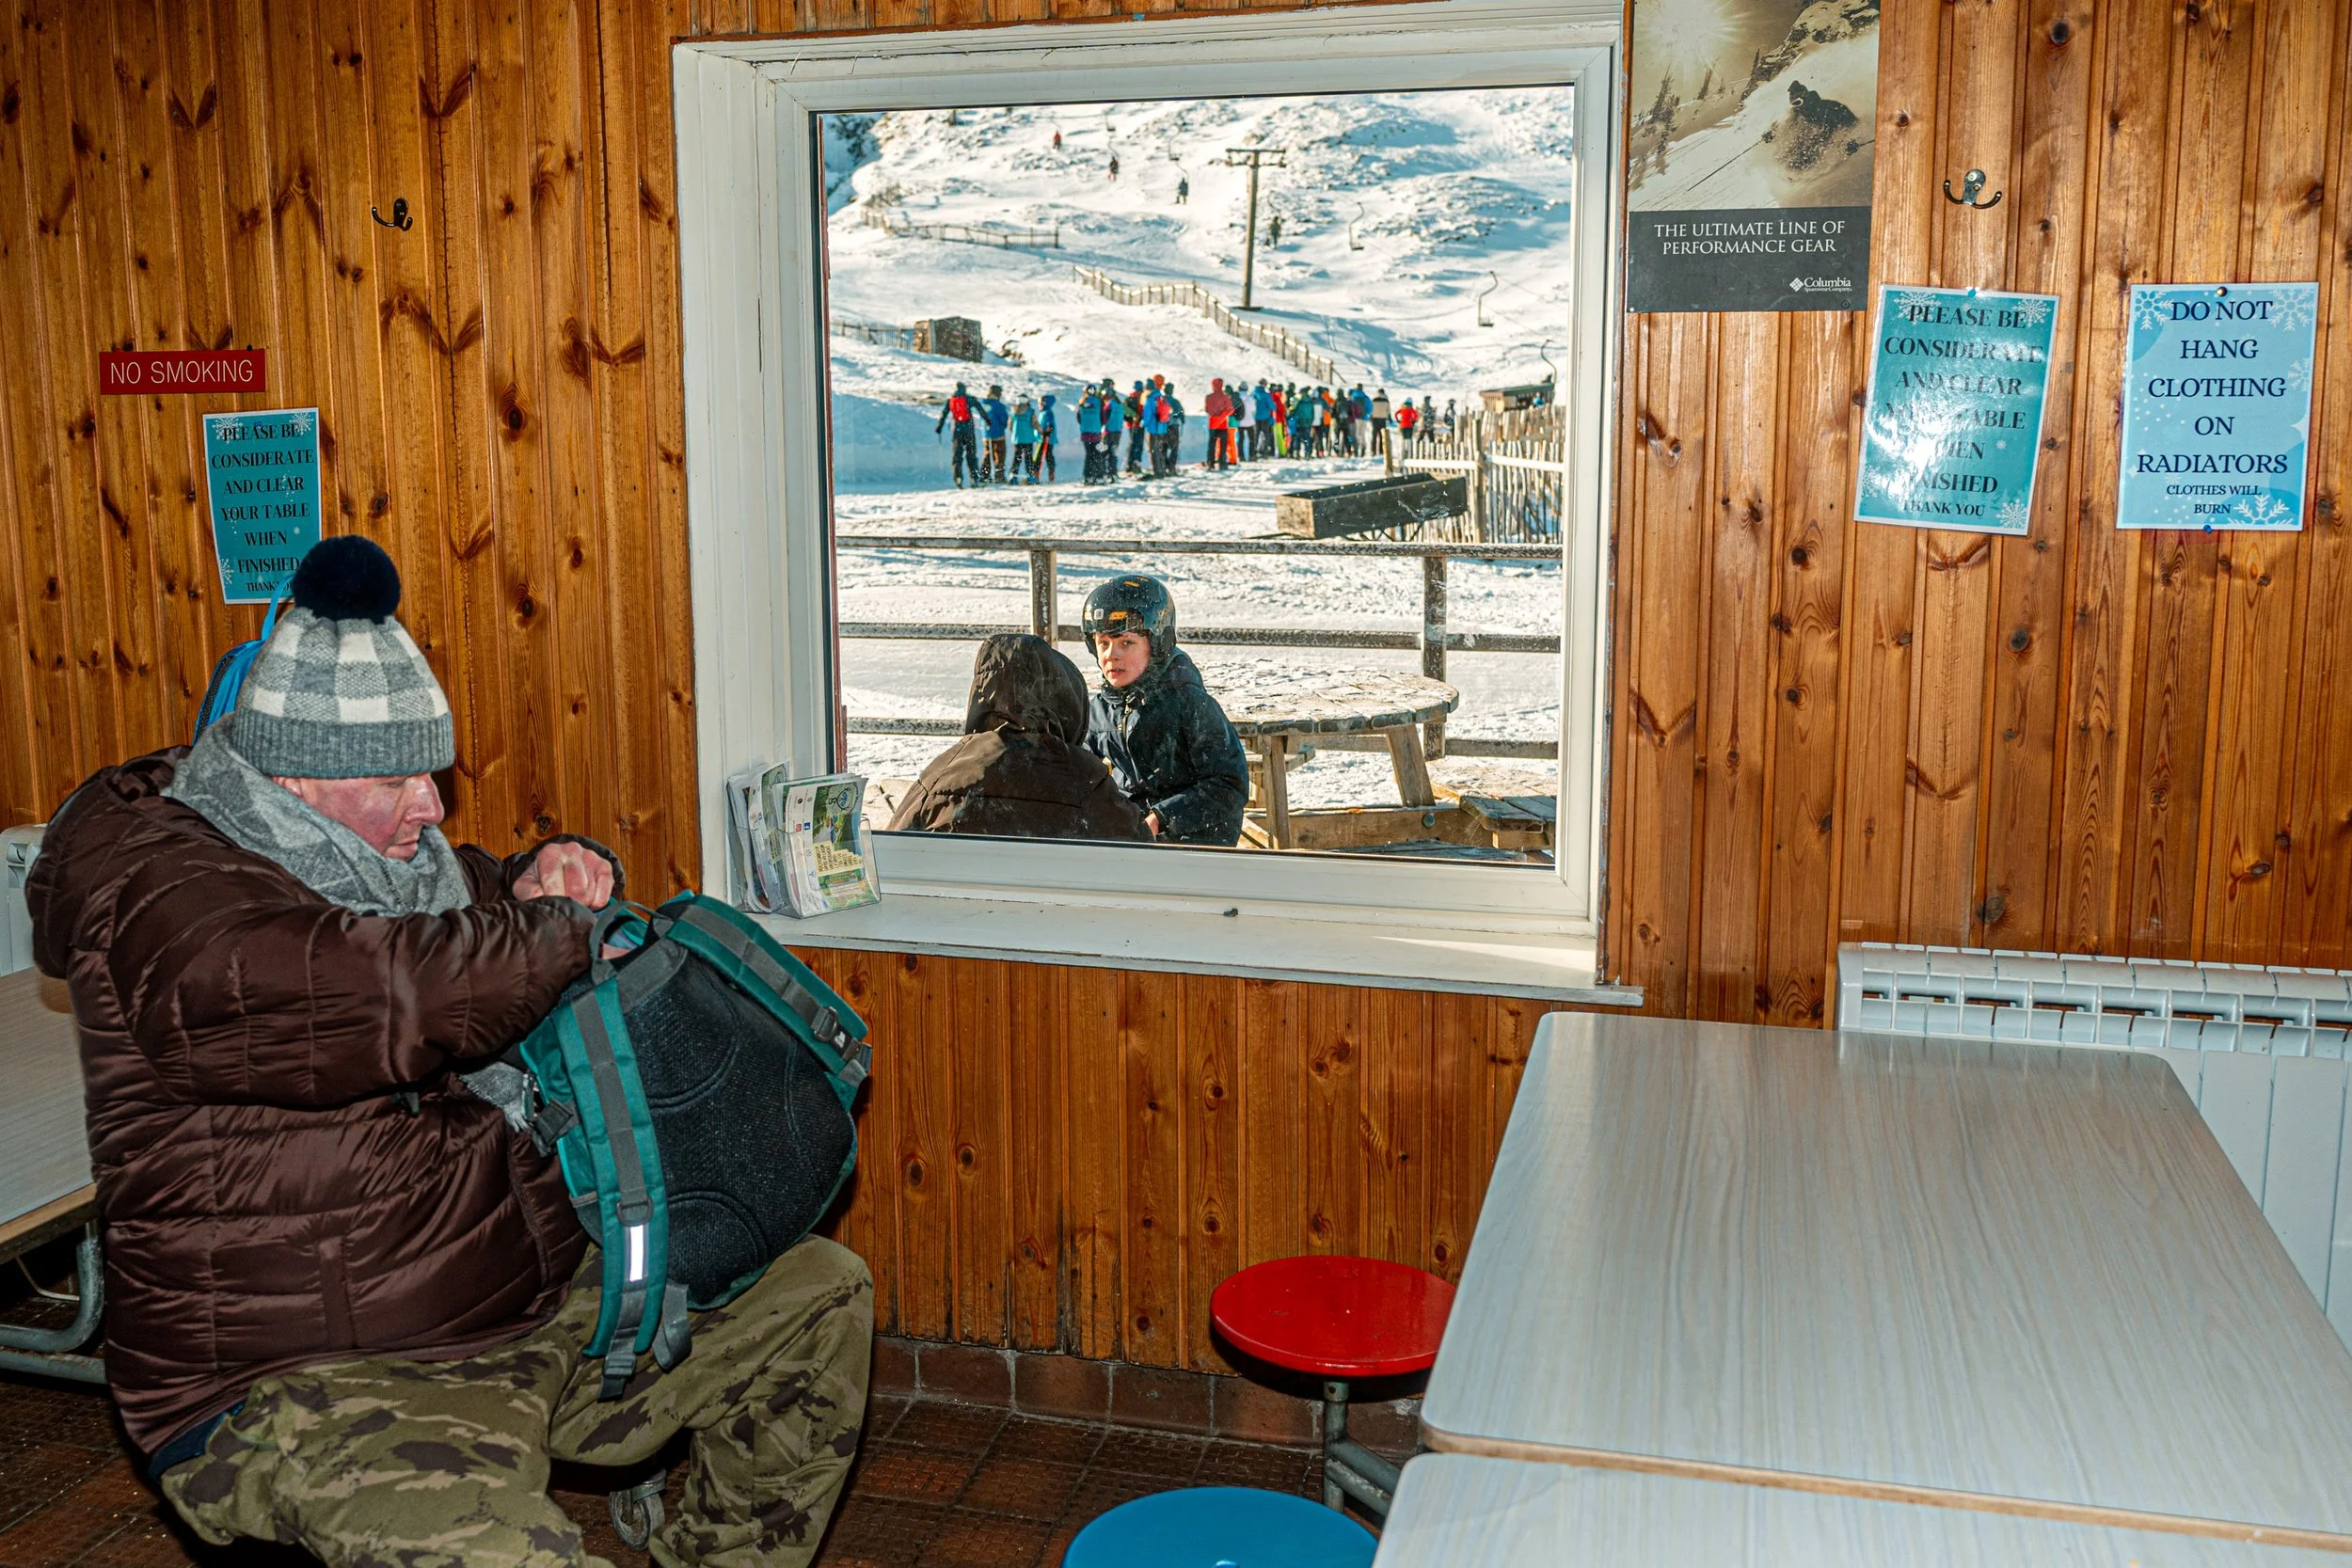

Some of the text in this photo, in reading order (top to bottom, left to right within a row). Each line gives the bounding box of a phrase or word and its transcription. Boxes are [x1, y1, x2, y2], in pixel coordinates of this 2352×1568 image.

[1654, 220, 1845, 237] THE ULTIMATE LINE OF
[1662, 239, 1836, 255] PERFORMANCE GEAR
[1804, 277, 1851, 288] Columbia
[1909, 305, 2026, 329] PLEASE BE
[2169, 300, 2273, 321] DO NOT
[2180, 339, 2258, 359] HANG
[110, 359, 253, 384] NO SMOKING
[1895, 371, 2022, 396] AND CLEAR
[2148, 377, 2286, 398] CLOTHING
[1955, 408, 2026, 430] ABLE
[2194, 416, 2234, 436] ON
[223, 423, 301, 441] PLEASE BE
[212, 449, 314, 468] CONSIDERATE
[2137, 454, 2288, 474] RADIATORS
[223, 477, 304, 495] AND CLEAR
[2166, 484, 2262, 496] CLOTHES WILL
[220, 503, 310, 522] YOUR TABLE
[1903, 499, 1986, 516] THANK YOU
[2193, 503, 2231, 515] BURN
[245, 531, 287, 546] WHEN
[237, 557, 300, 573] FINISHED
[246, 580, 275, 592] THANK
